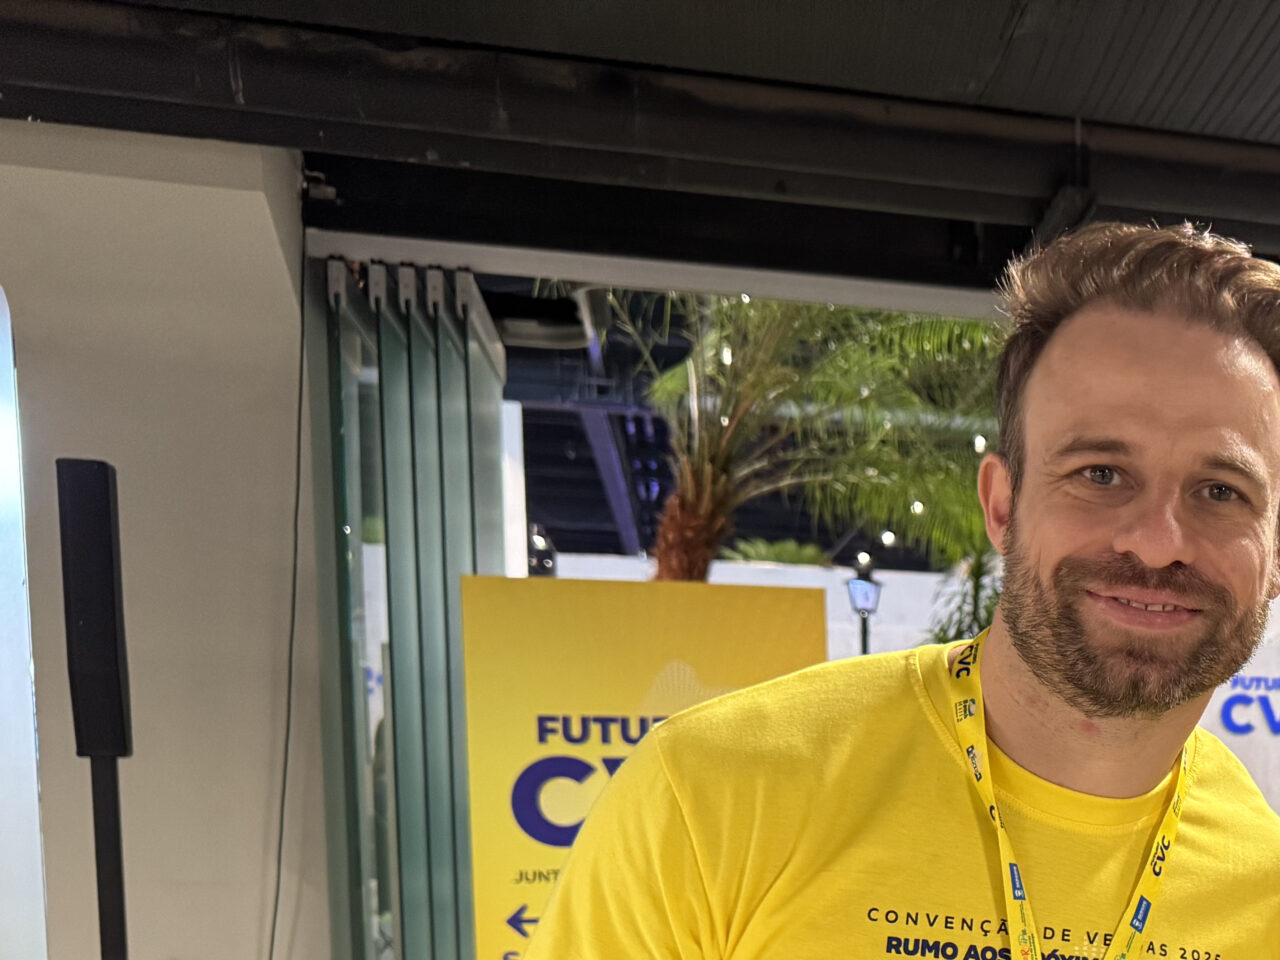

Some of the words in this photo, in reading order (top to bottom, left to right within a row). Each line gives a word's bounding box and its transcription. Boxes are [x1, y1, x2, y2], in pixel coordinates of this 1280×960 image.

[536, 715, 668, 745] FUTU
[1152, 834, 1171, 877] CVC
[513, 868, 560, 885] JUNT
[867, 907, 1009, 937] CONVENÇÃ
[1043, 926, 1071, 942] DE
[1086, 930, 1168, 957] VEAS
[886, 936, 959, 960] RUMO
